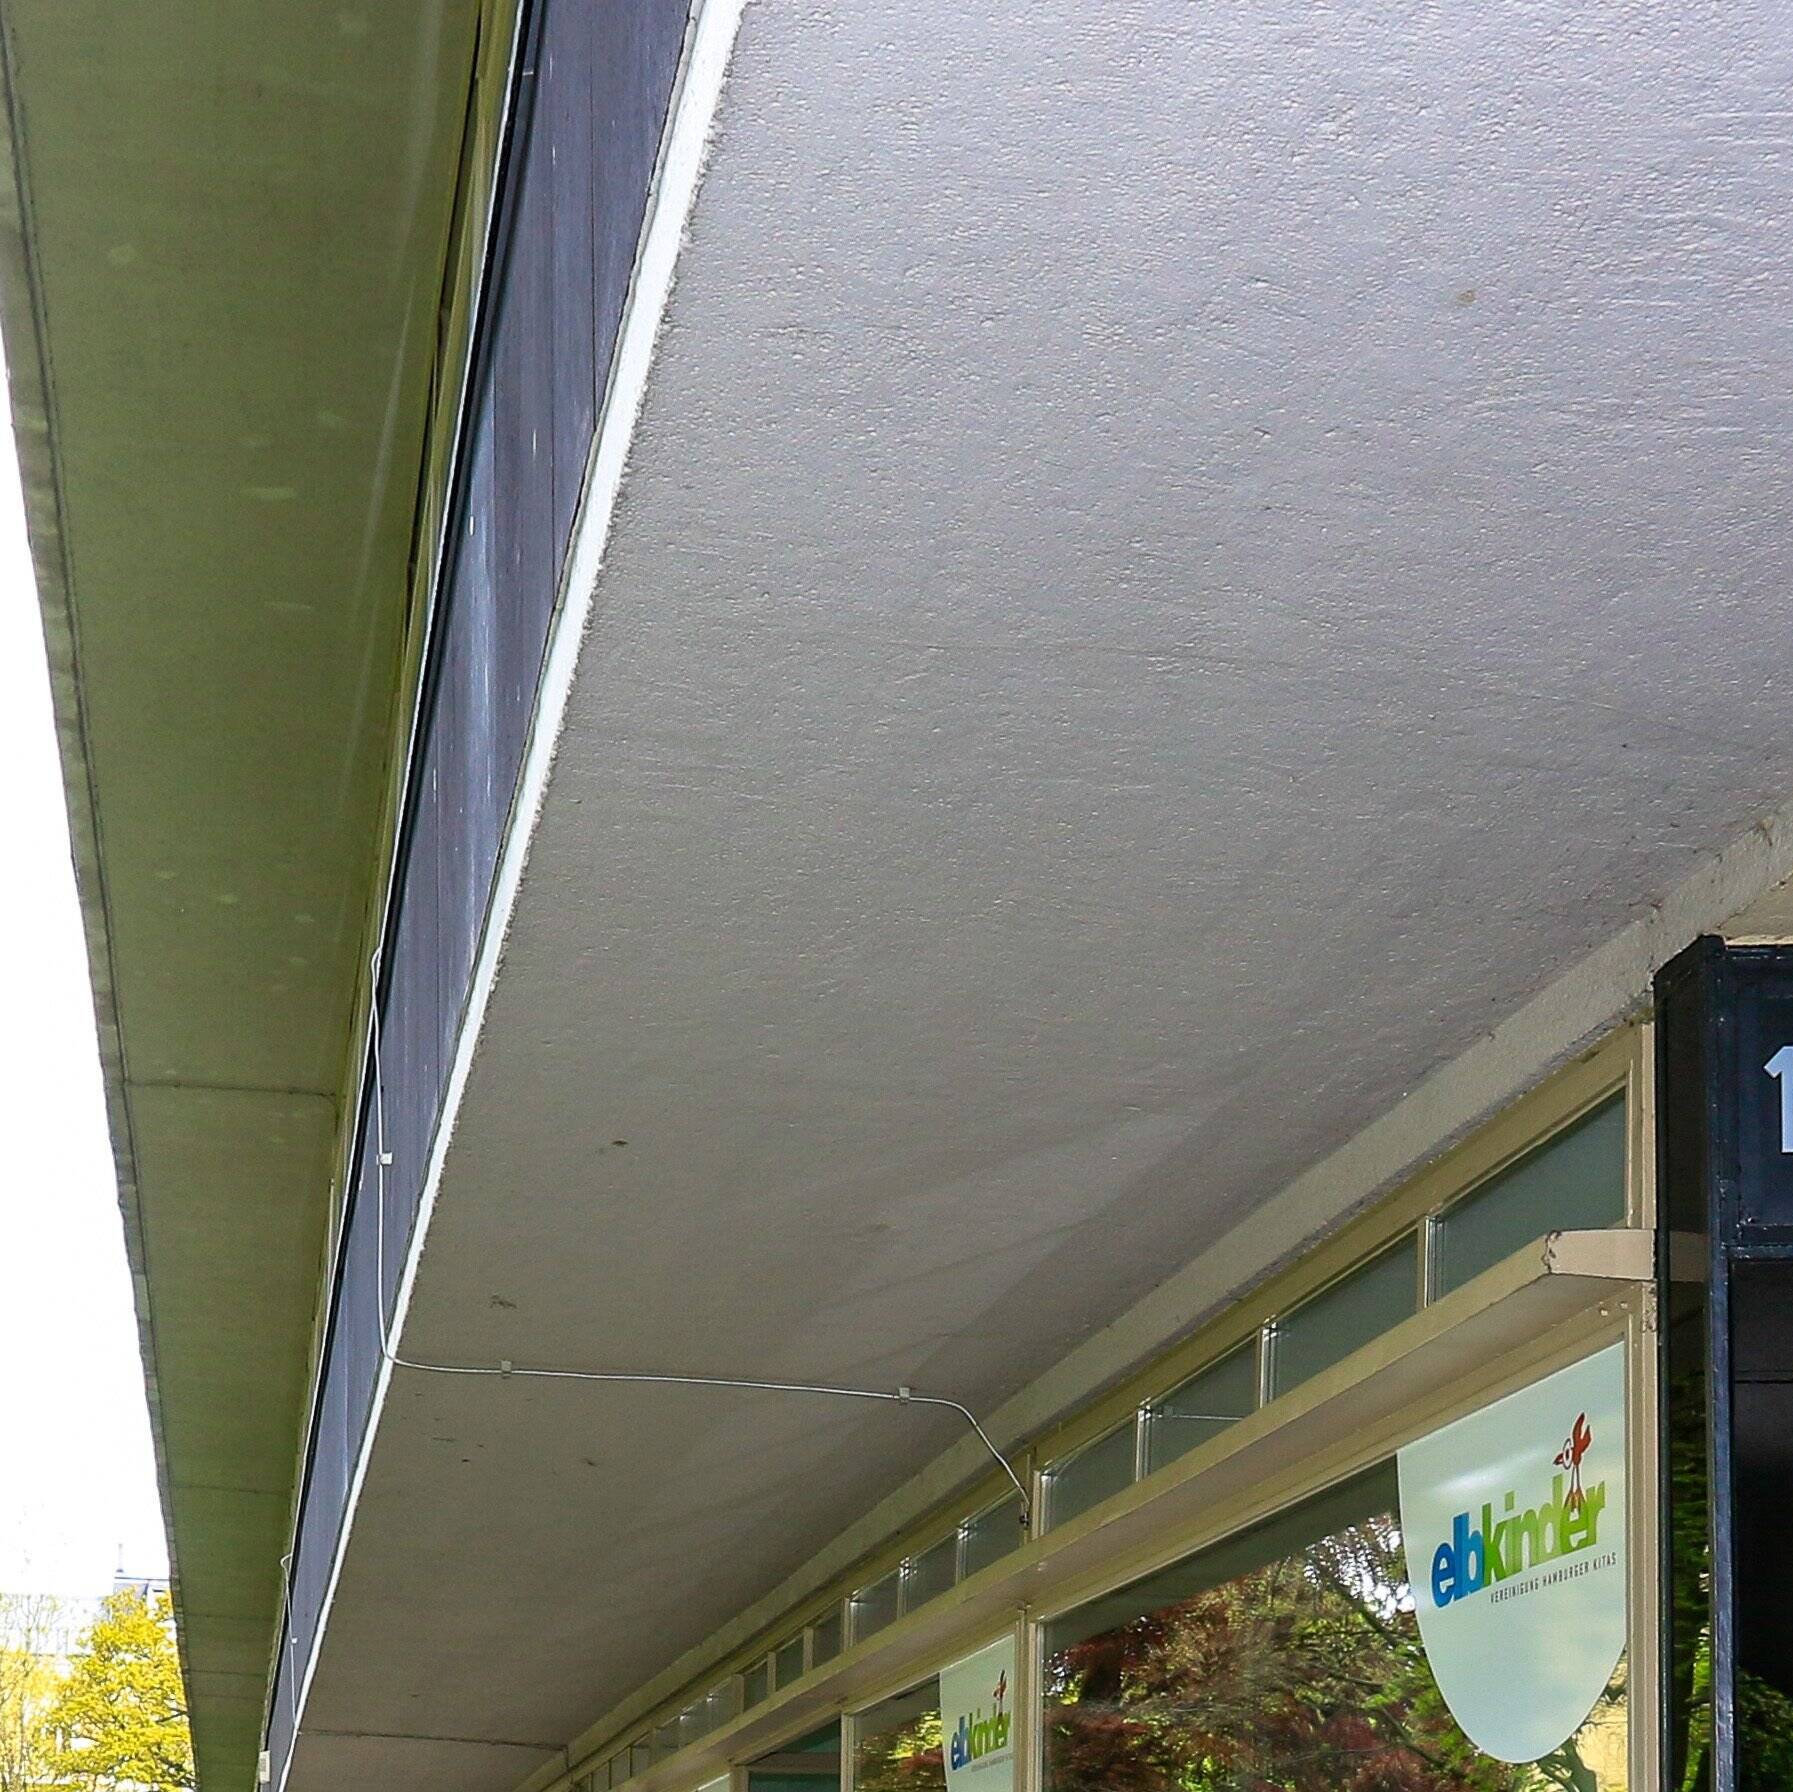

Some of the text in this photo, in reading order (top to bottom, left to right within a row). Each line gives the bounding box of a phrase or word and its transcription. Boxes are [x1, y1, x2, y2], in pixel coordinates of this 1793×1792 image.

[1431, 1473, 1606, 1608] elbkinder
[1490, 1552, 1617, 1604] VEREINIGUNG HAMBURGER KITAS
